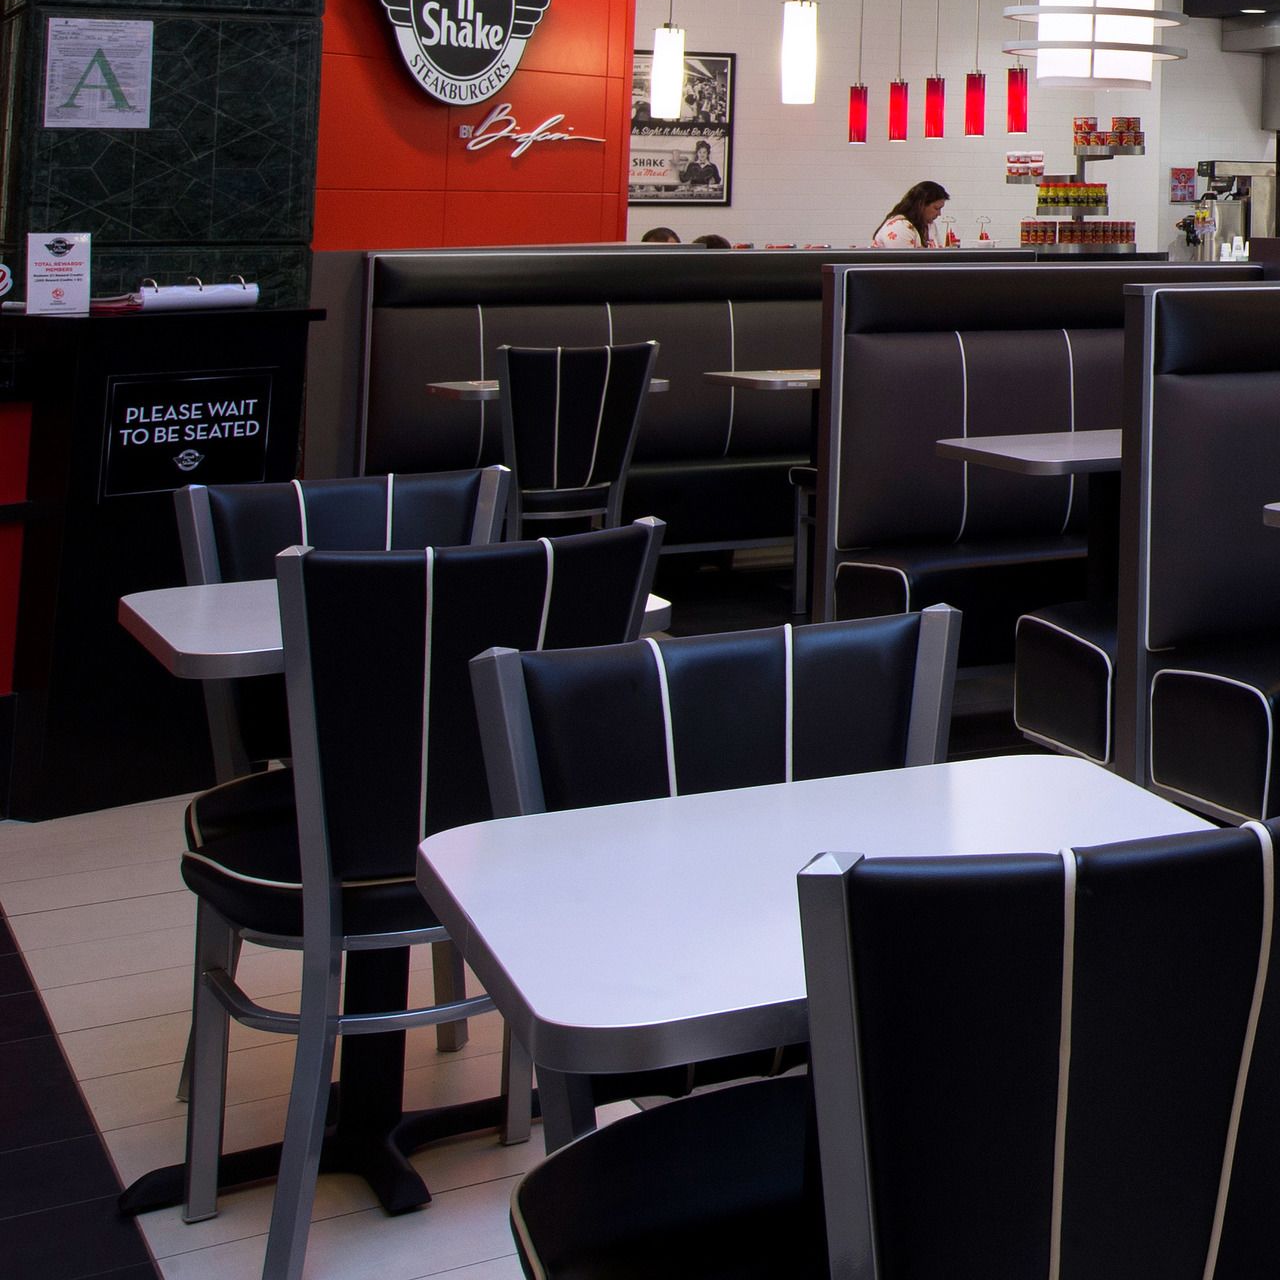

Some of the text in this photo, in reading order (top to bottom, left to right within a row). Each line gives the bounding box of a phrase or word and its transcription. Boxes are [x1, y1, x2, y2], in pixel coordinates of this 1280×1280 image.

[421, 1, 504, 51] Shake
[57, 47, 131, 108] A
[410, 52, 511, 101] STEAKBURGERS
[641, 126, 662, 137] Sight
[671, 127, 690, 136] Must
[703, 127, 724, 138] Right
[632, 157, 665, 168] SHAKE
[125, 399, 258, 424] PLEASE WAIT
[120, 420, 260, 446] TO BE SEATED
